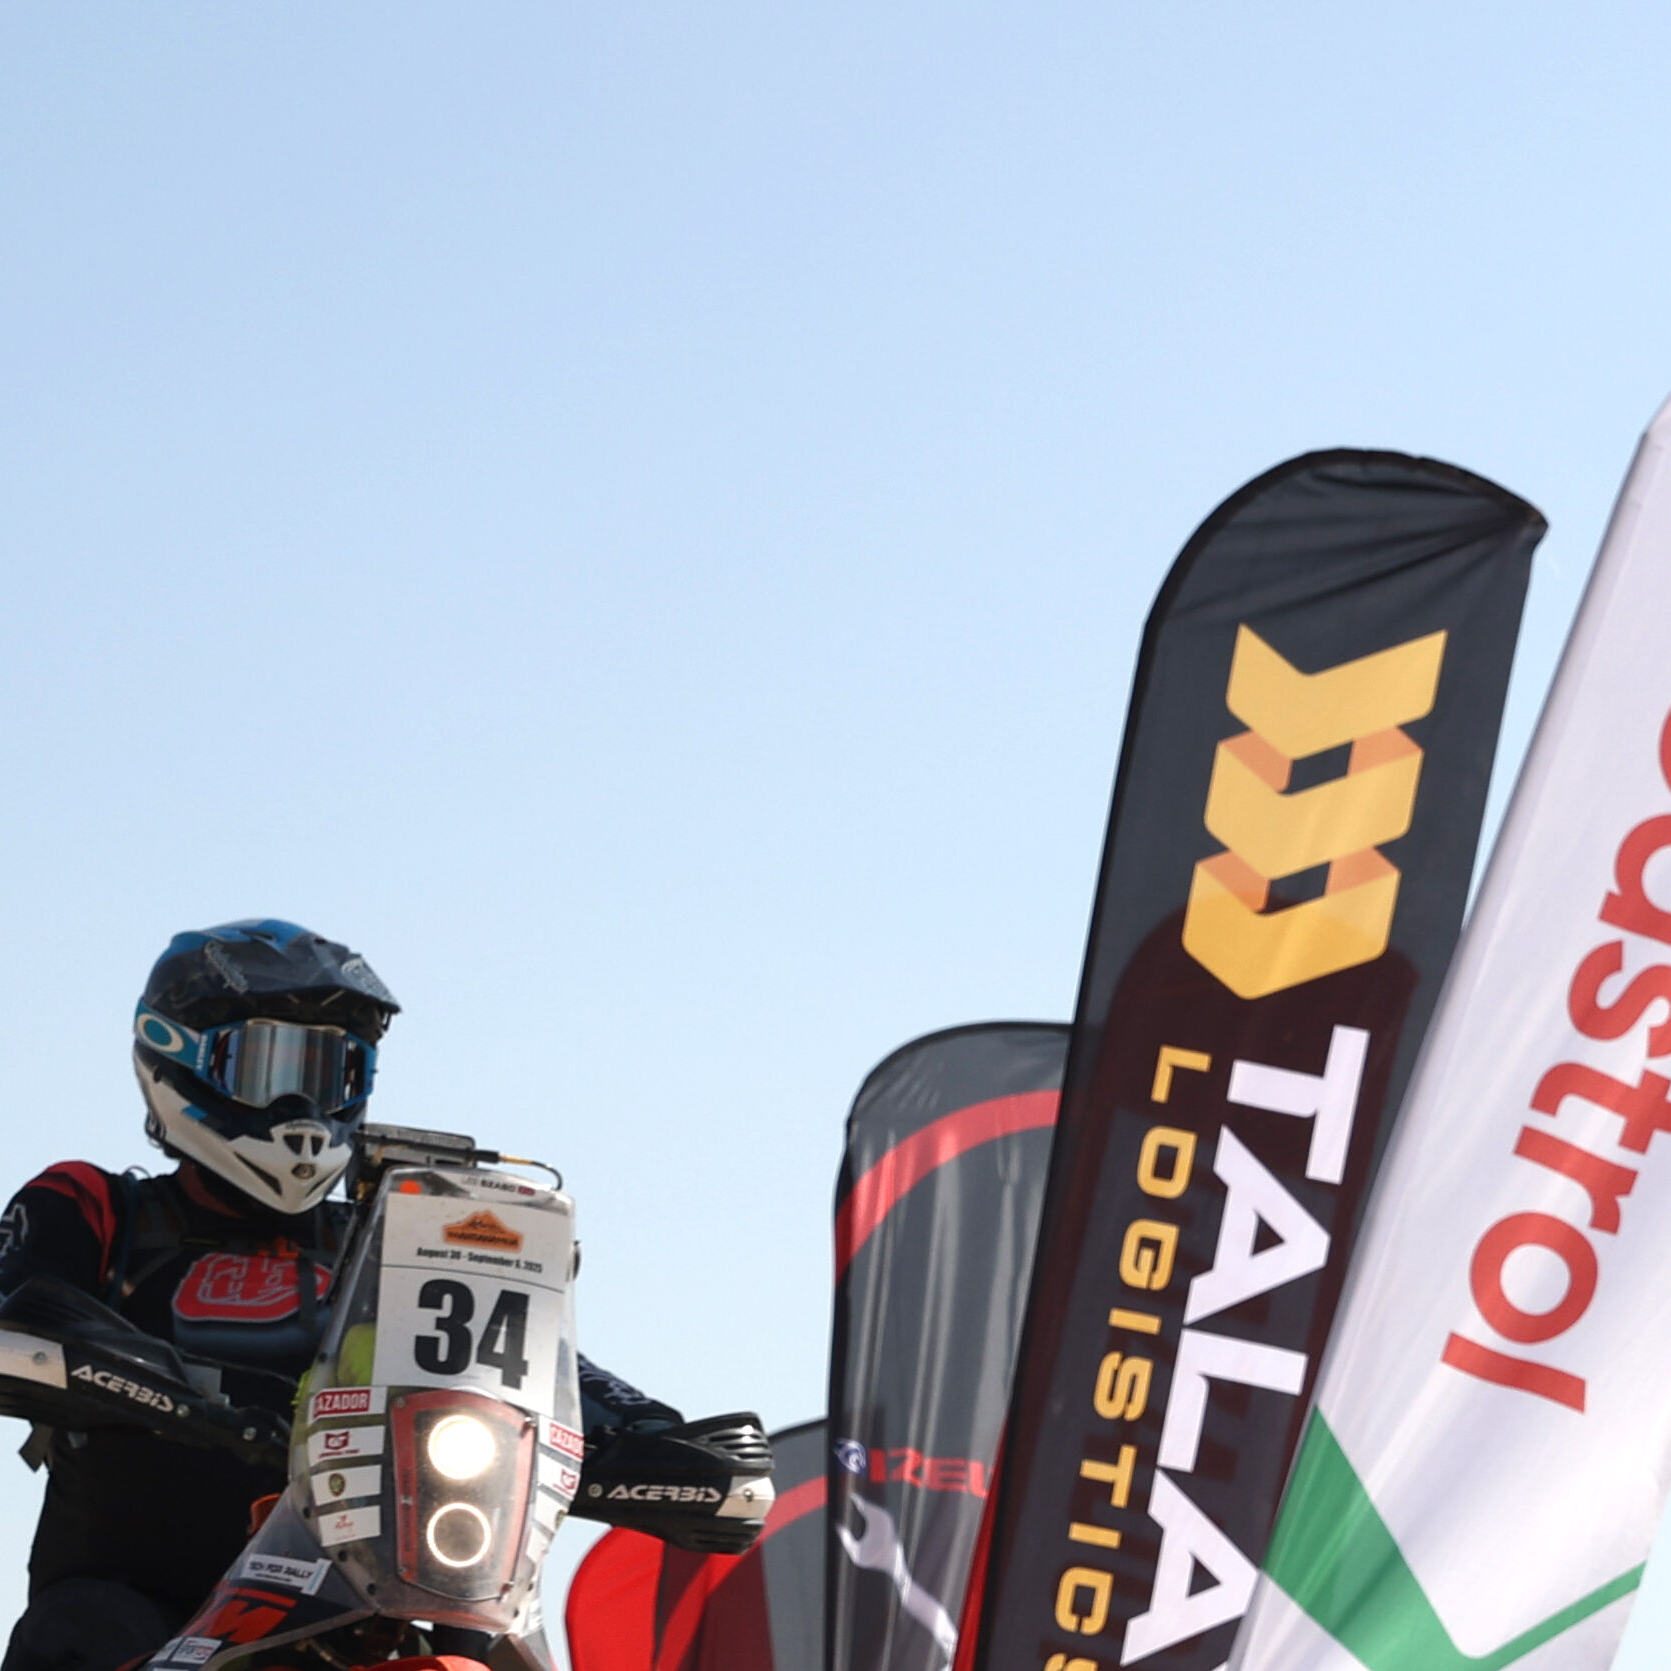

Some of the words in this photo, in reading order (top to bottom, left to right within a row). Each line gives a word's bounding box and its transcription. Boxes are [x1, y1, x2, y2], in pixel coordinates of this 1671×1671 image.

[413, 1278, 531, 1391] 34
[71, 1364, 174, 1413] ACERBIS
[315, 1392, 368, 1412] AZADOR
[607, 1484, 723, 1502] ACERBIS
